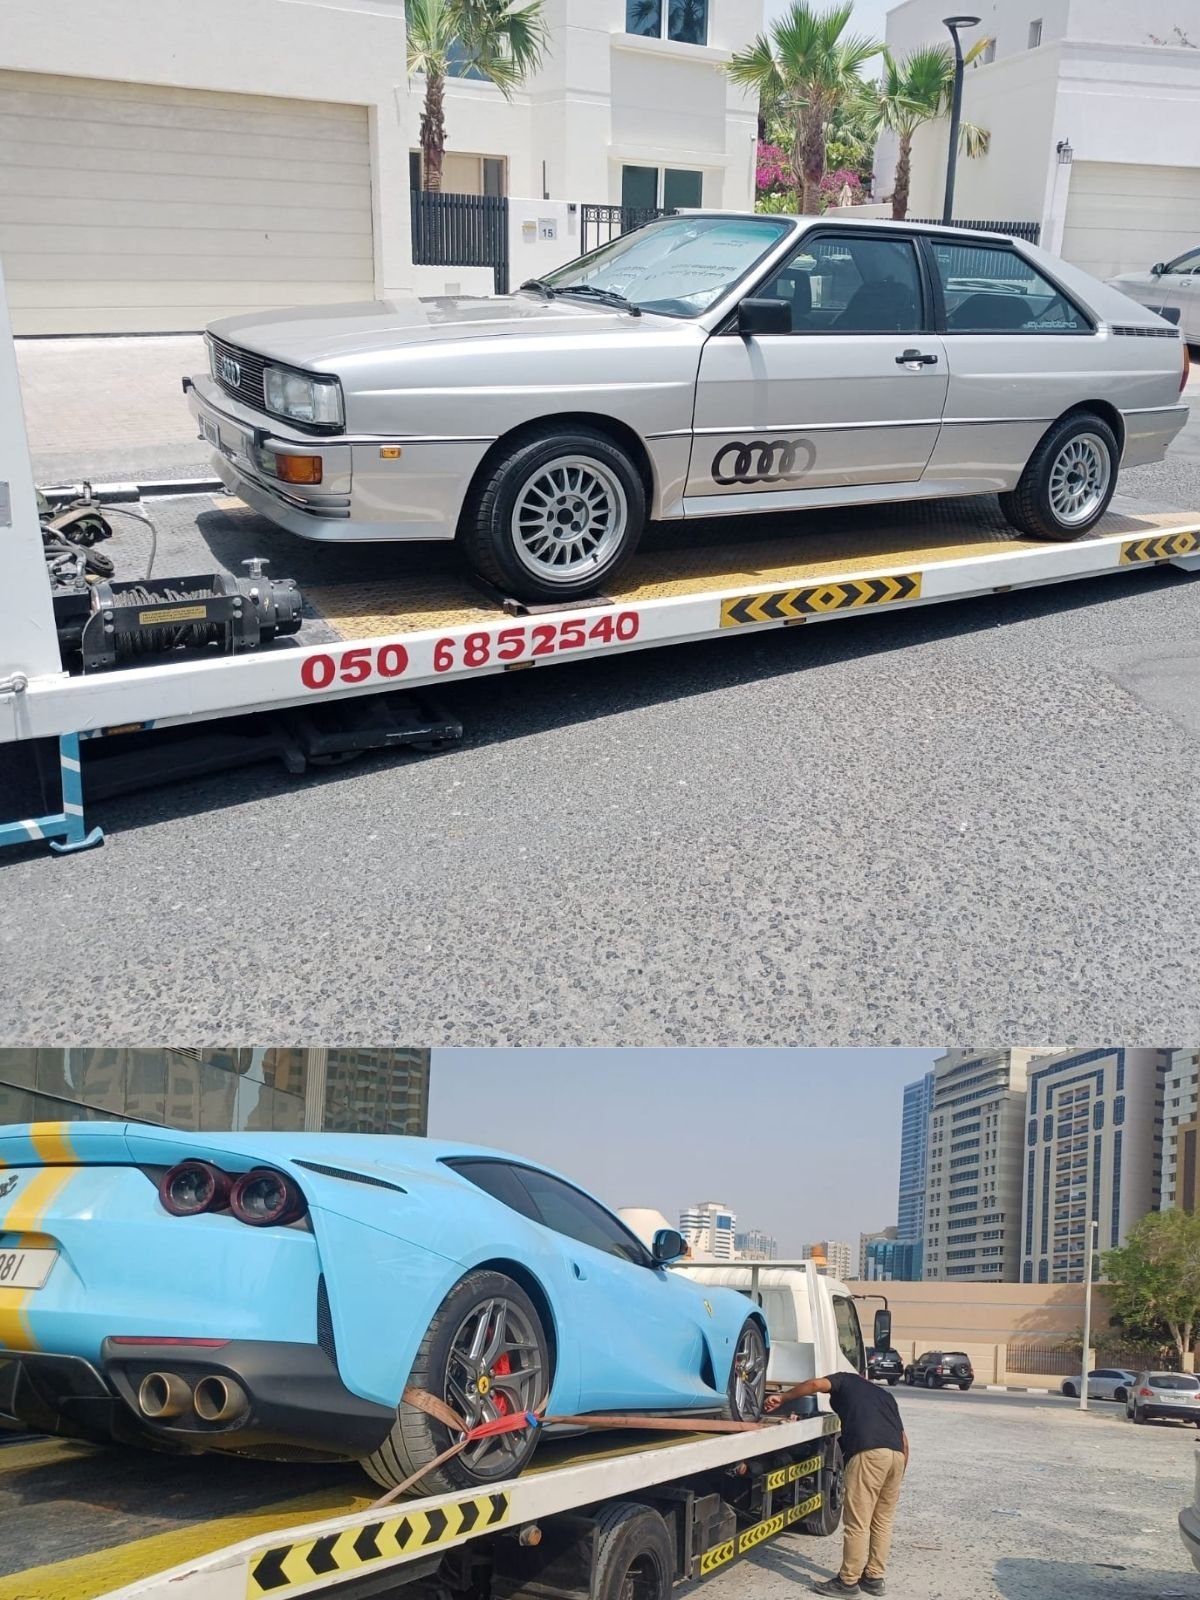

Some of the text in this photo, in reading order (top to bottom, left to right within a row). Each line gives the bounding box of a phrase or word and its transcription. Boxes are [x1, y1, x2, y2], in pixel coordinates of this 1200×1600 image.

[543, 228, 554, 238] 15
[1023, 320, 1078, 330] quattro
[300, 611, 640, 689] 050 6852540
